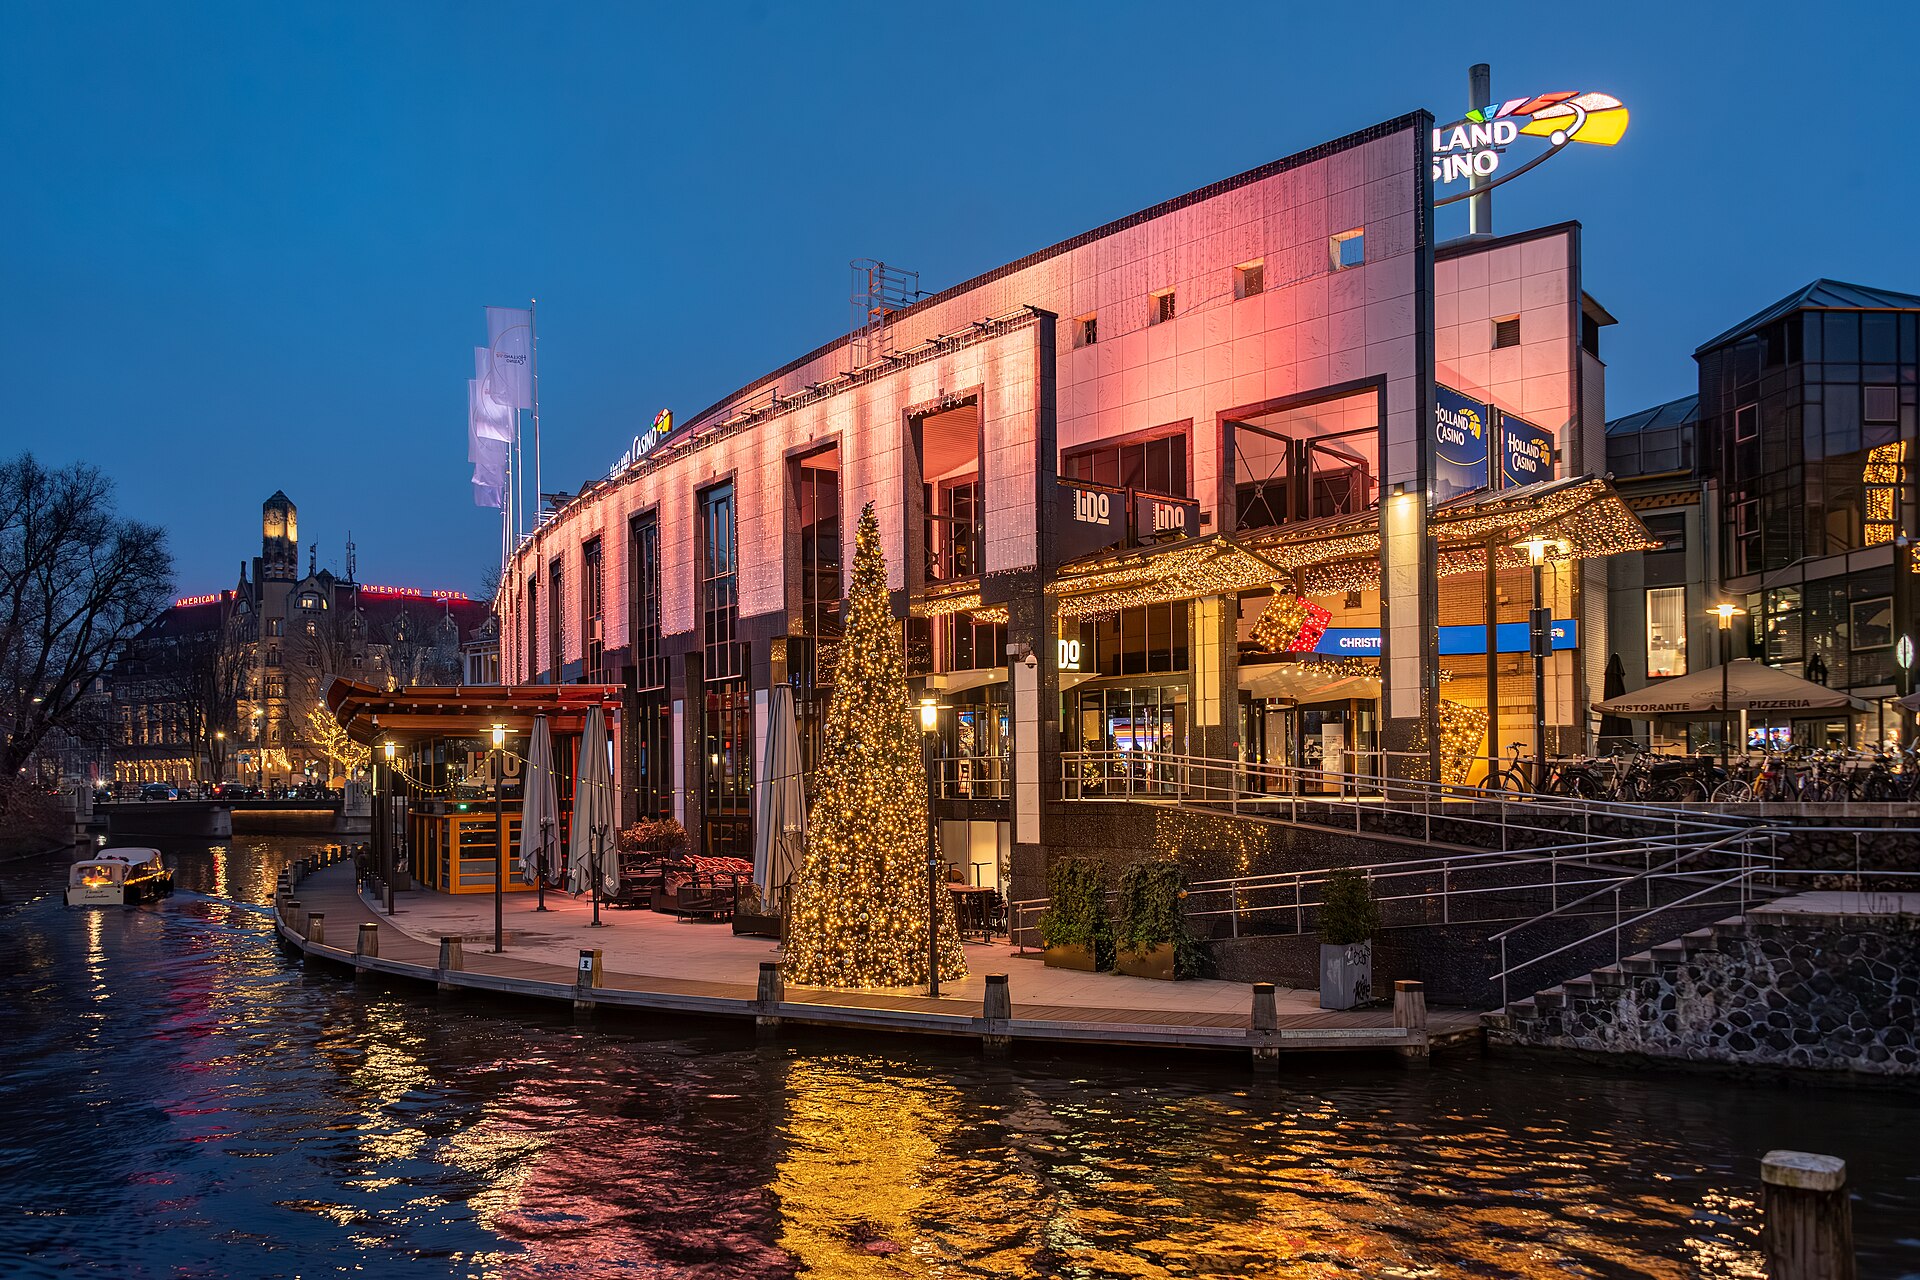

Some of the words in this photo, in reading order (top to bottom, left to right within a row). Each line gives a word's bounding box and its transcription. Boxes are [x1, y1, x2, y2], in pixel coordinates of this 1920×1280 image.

[1433, 120, 1518, 152] LAND
[1433, 150, 1499, 183] SINO
[632, 426, 657, 463] CASINO
[1436, 423, 1465, 446] CASINO
[1508, 432, 1540, 459] HOLLAND
[1512, 453, 1537, 473] CASINO
[176, 594, 215, 607] AMERICAN
[363, 584, 421, 596] AMERICAN
[432, 590, 468, 600] HOTEL
[1058, 639, 1080, 669] DO
[1613, 702, 1690, 713] RISTORANTE
[1749, 699, 1811, 709] PIZZERIA
